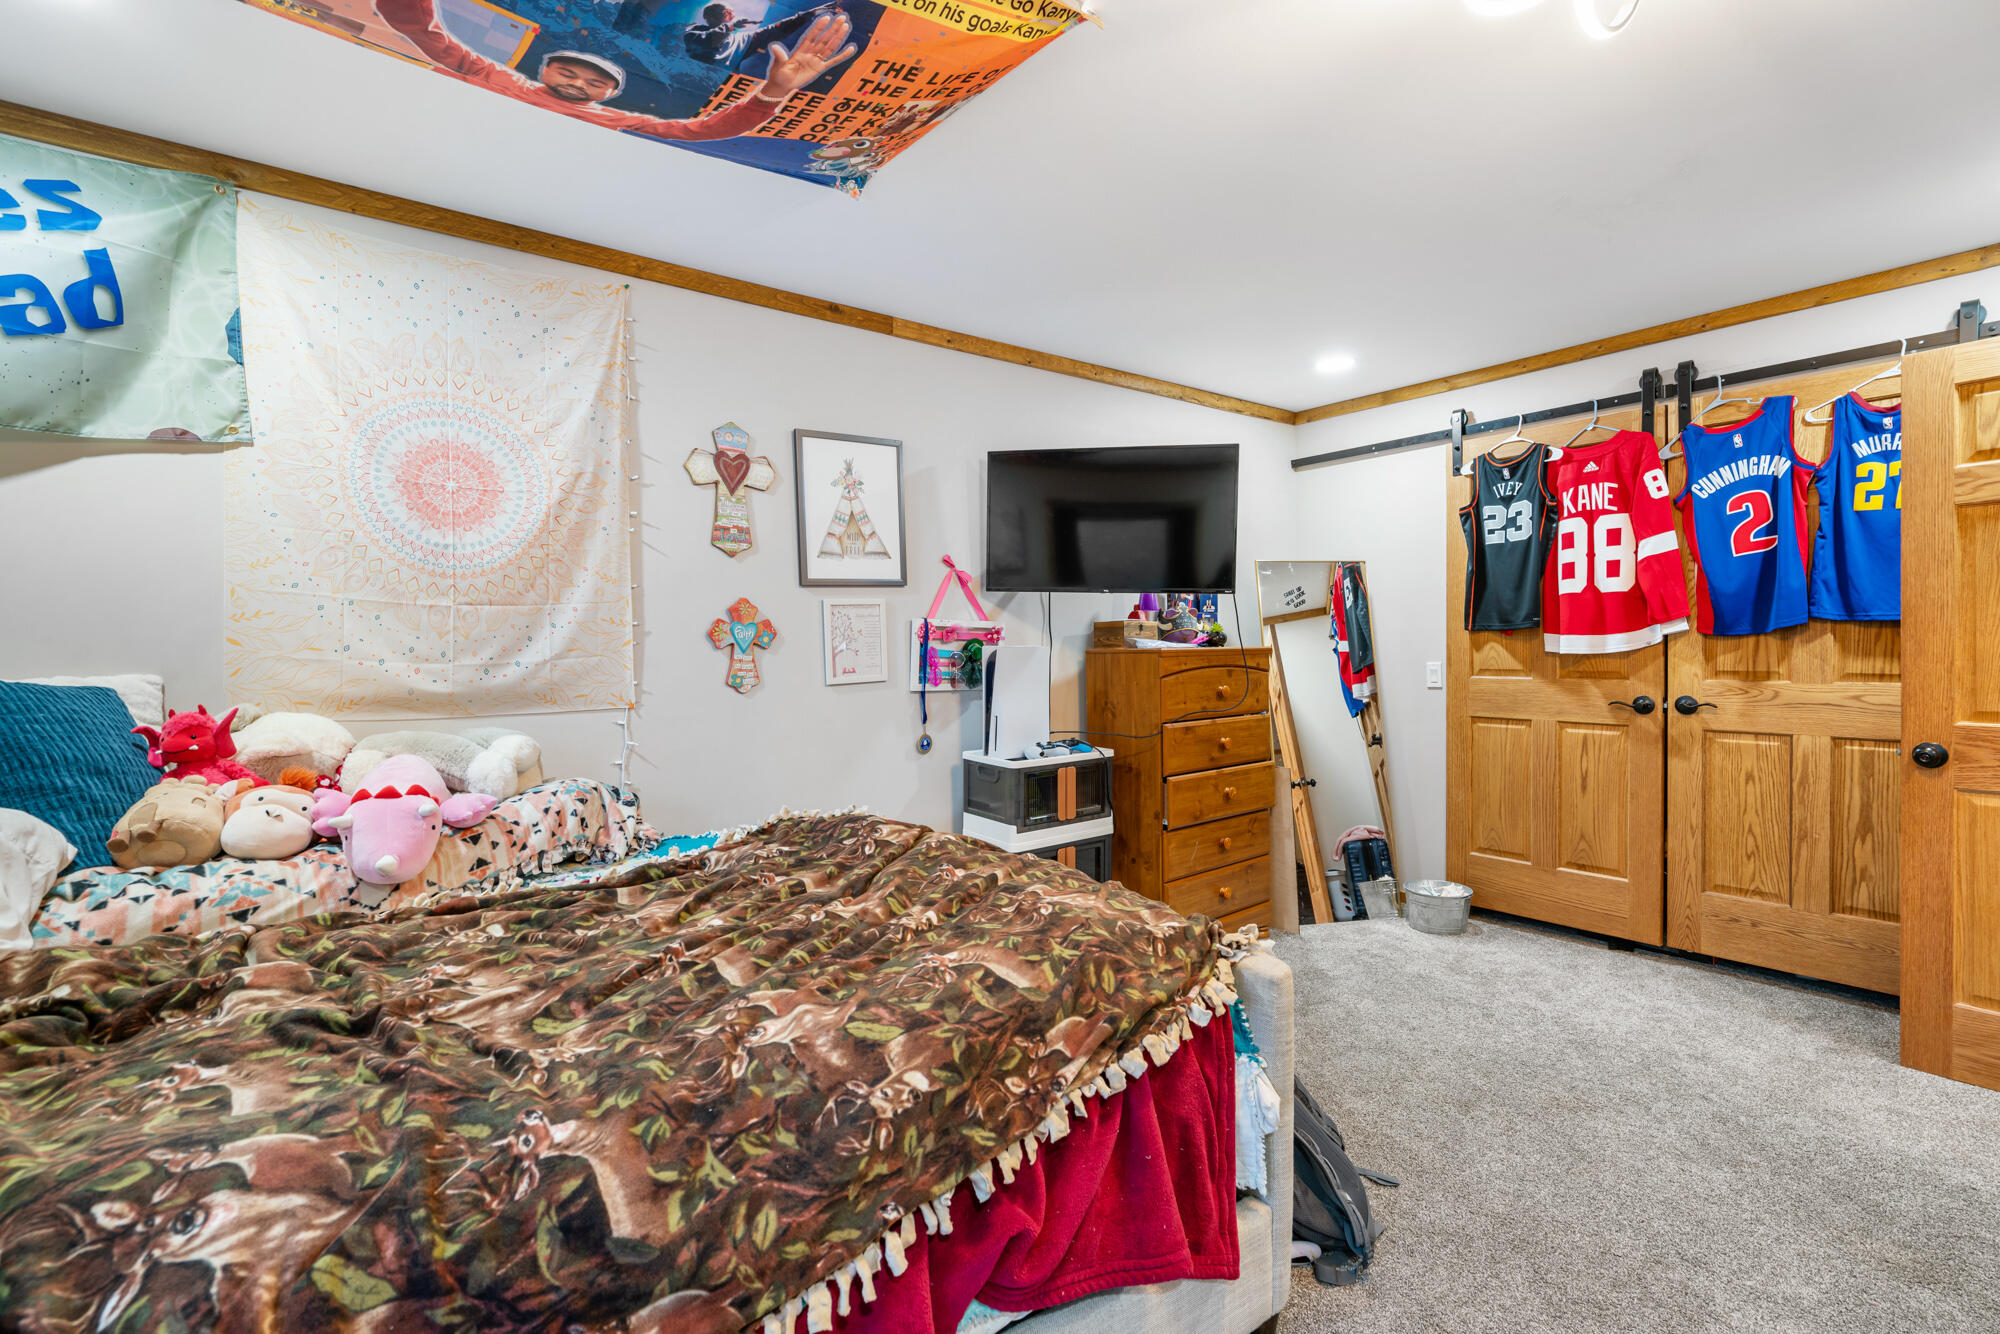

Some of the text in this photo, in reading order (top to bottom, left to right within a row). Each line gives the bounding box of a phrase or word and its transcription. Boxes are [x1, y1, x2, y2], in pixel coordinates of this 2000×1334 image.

[913, 0, 936, 14] on
[938, 1, 965, 24] his
[966, 13, 1013, 33] goals
[1010, 0, 1035, 14] Go
[857, 78, 907, 98] THE
[910, 87, 964, 99] LIFE
[871, 59, 919, 83] THE
[926, 72, 980, 86] LIFE
[1493, 481, 1523, 498] IVEY
[1691, 454, 1792, 499] CUNNINGHAM
[1562, 481, 1619, 517] KANE
[1482, 500, 1532, 545] 23
[1726, 489, 1778, 557] 2
[1557, 512, 1637, 596] 88
